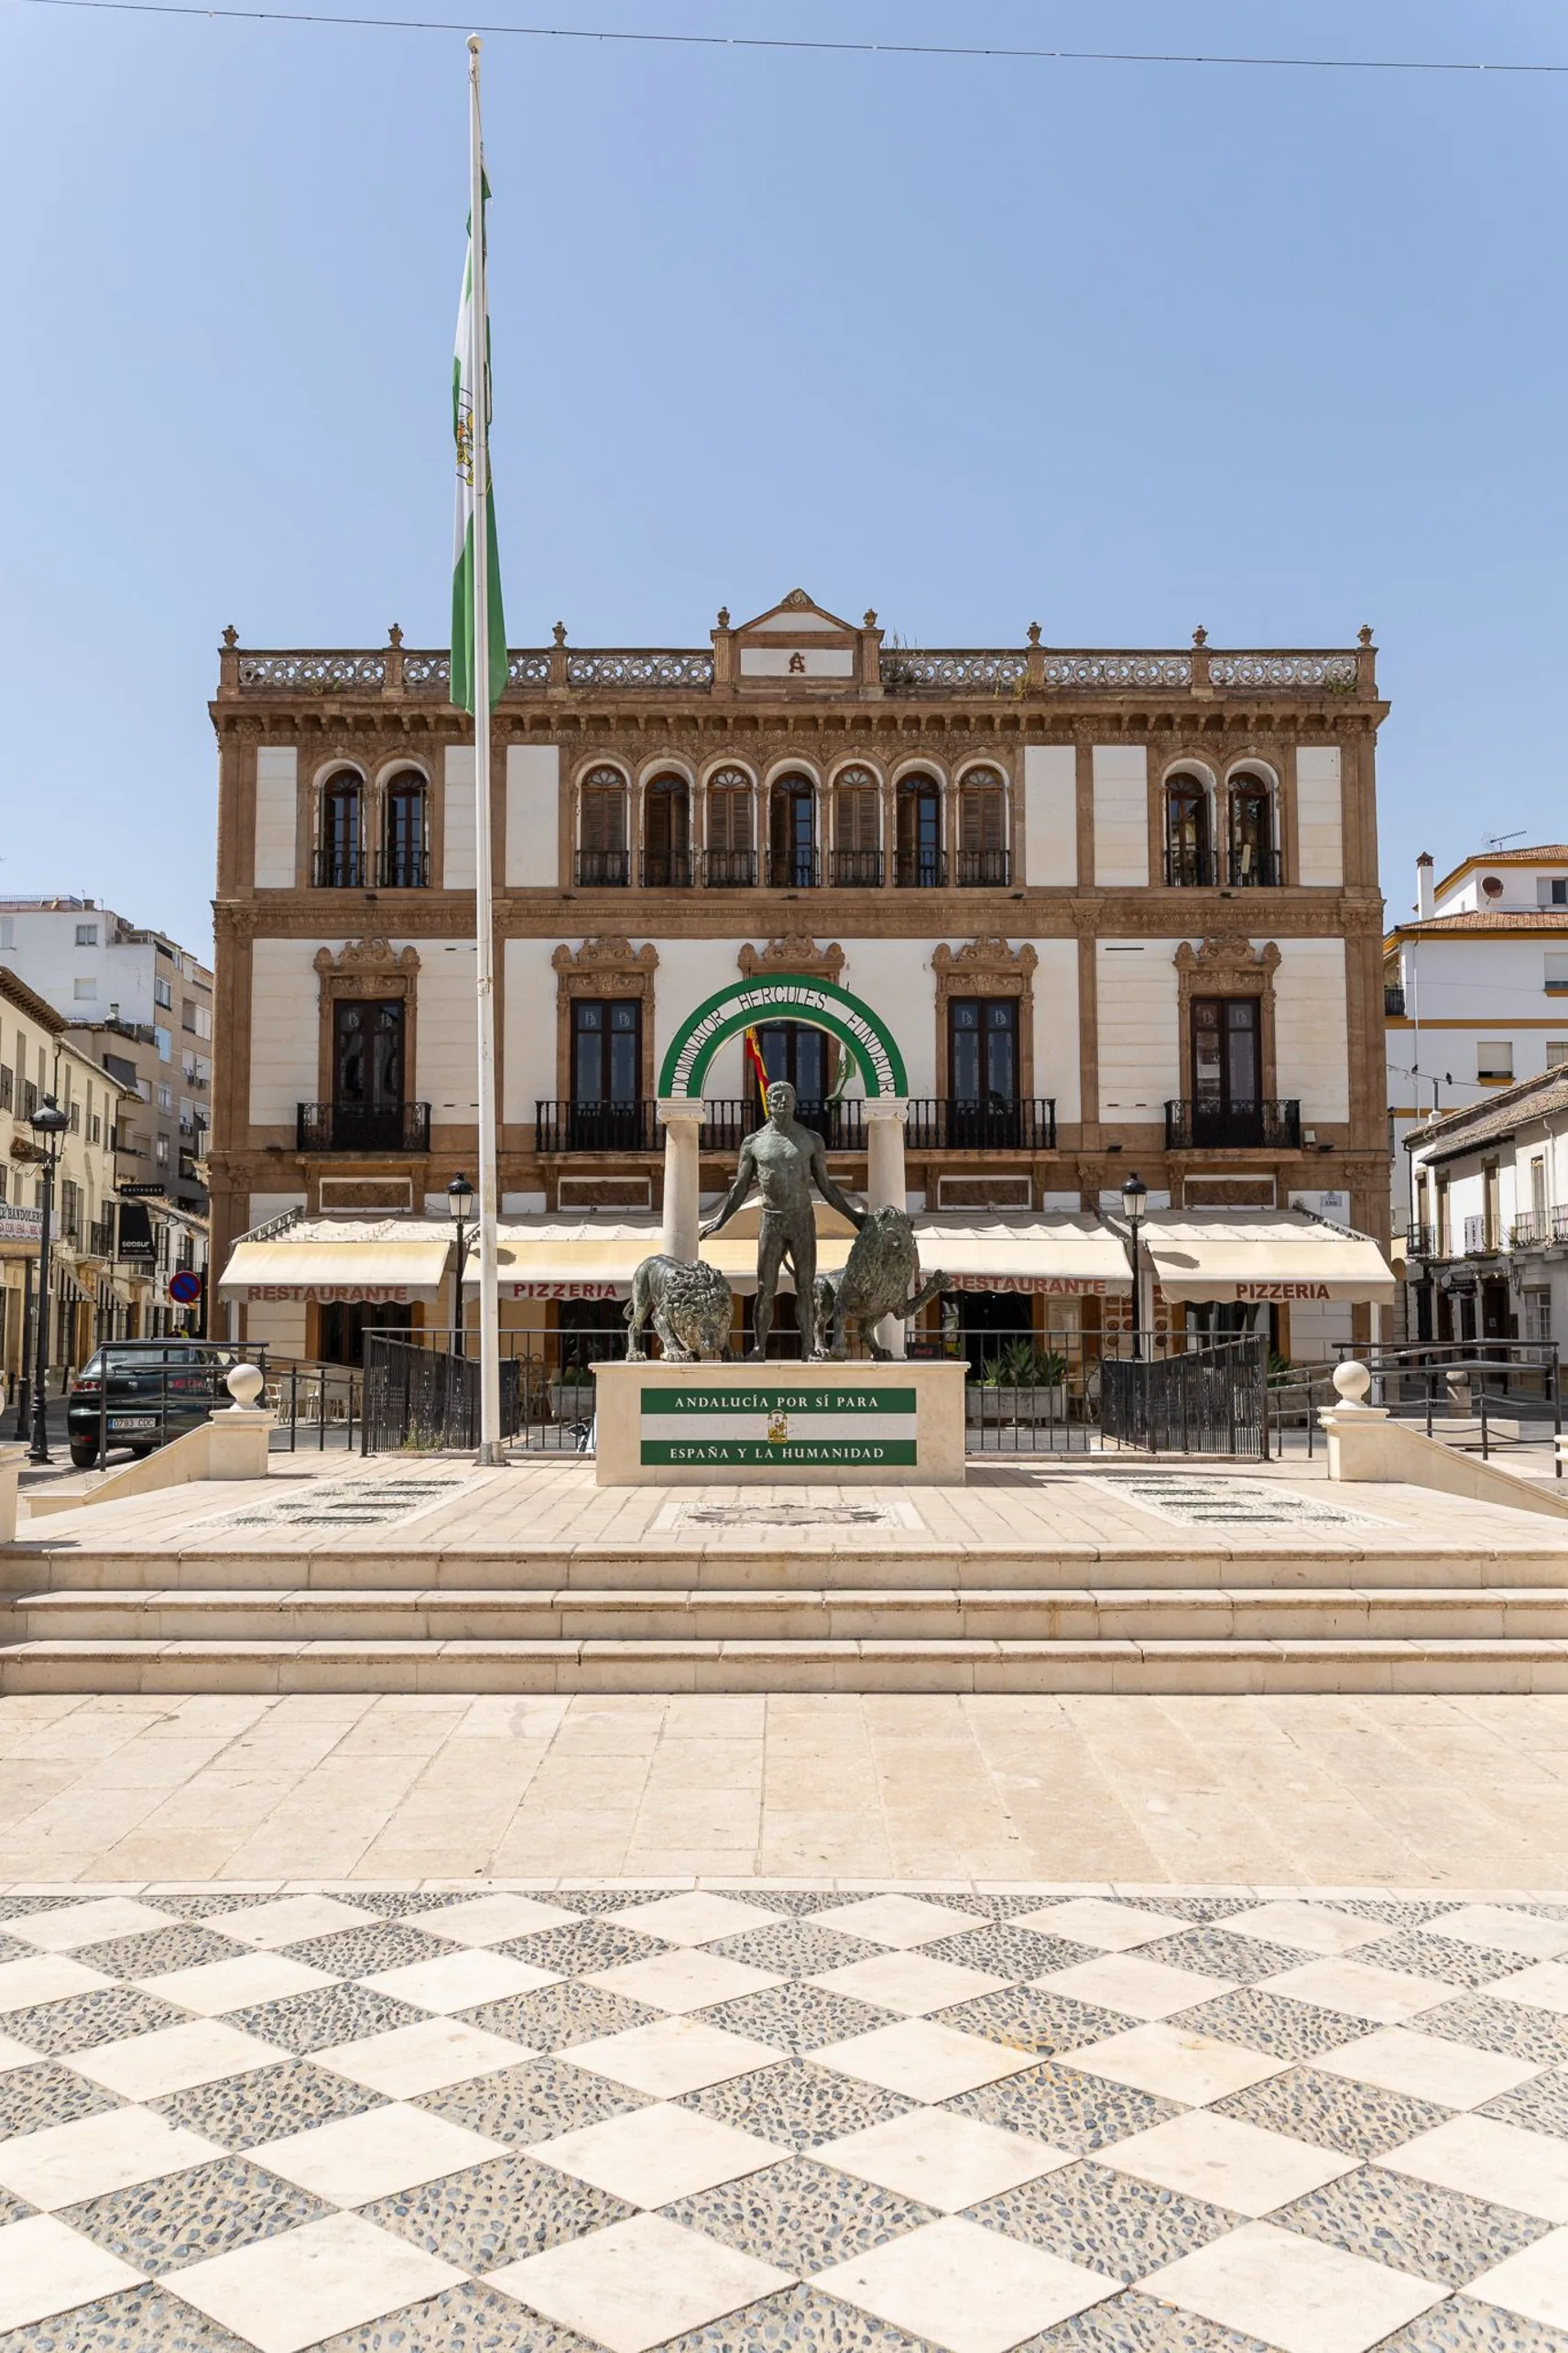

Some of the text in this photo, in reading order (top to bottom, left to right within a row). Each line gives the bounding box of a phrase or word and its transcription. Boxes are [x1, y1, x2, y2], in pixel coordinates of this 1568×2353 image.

[670, 984, 897, 1095] DOMINATOR HERCULES FUNDATOR
[514, 1283, 617, 1297] PIZZERIA
[948, 1275, 1106, 1294] RESTAURANTE
[1236, 1283, 1331, 1299] PIZZERIA
[247, 1285, 408, 1301] RESTAURANTE
[675, 1394, 879, 1408] ANDALUCÍA POR SÍ PARA
[114, 1419, 134, 1428] 0793
[670, 1446, 885, 1459] ESPAÑA Y LA HUMANIDAD
